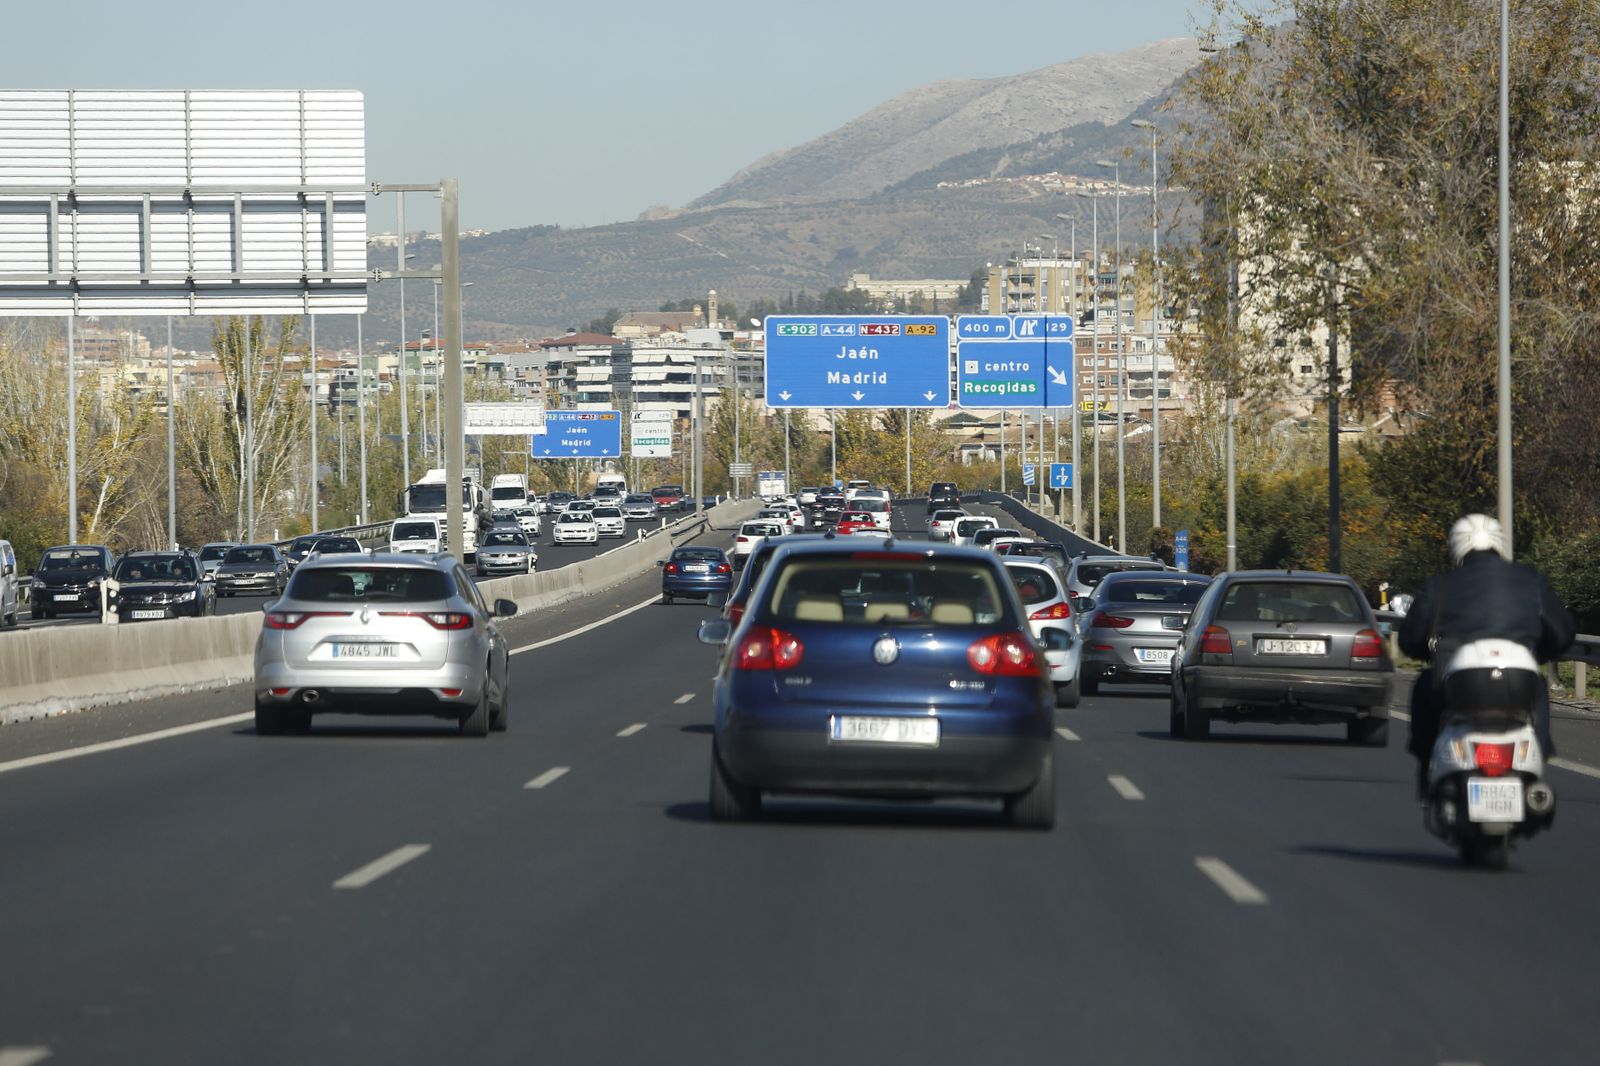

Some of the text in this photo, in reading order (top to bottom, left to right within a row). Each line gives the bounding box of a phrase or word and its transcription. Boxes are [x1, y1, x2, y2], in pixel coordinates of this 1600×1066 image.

[778, 324, 936, 335] E-902 A-44 N-432 A-92
[964, 323, 1006, 333] 400 m
[1046, 323, 1067, 332] 129
[836, 346, 879, 359] Jaén
[985, 361, 1030, 372] centro
[827, 371, 888, 385] Madrid
[964, 382, 1036, 394] Recogidas
[561, 439, 591, 447] Madrid
[340, 646, 397, 657] 4845 JWL
[1146, 651, 1168, 660] 8508
[847, 717, 890, 737] 3667
